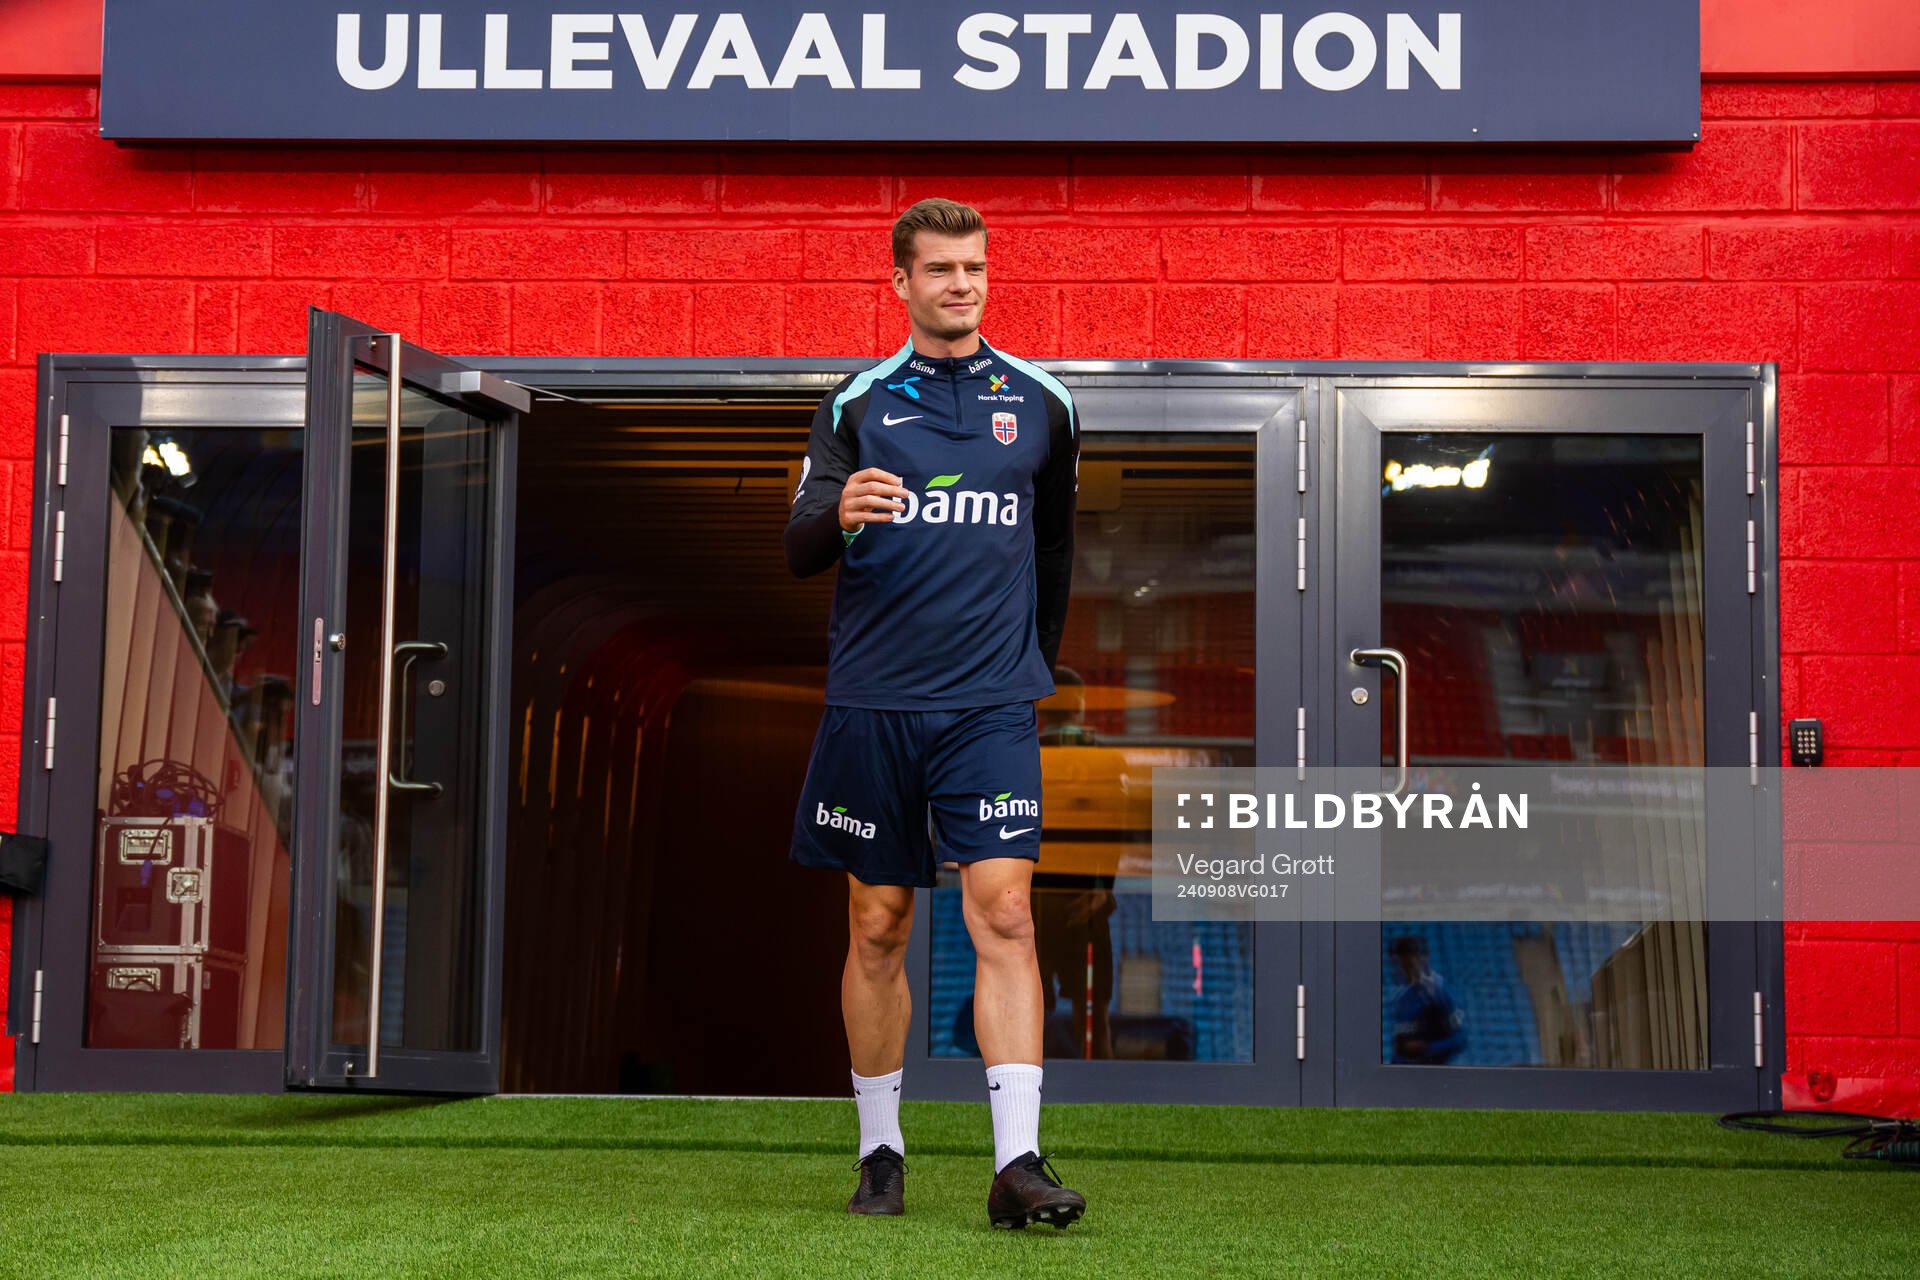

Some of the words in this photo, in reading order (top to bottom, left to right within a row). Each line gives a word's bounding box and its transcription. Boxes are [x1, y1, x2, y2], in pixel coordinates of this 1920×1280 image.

[335, 13, 922, 91] ULLEVAAL
[955, 12, 1463, 92] STADION
[909, 359, 936, 376] bama
[968, 358, 993, 374] bama
[999, 394, 1024, 403] Tipping
[979, 798, 1038, 821] bama
[816, 802, 877, 839] bama
